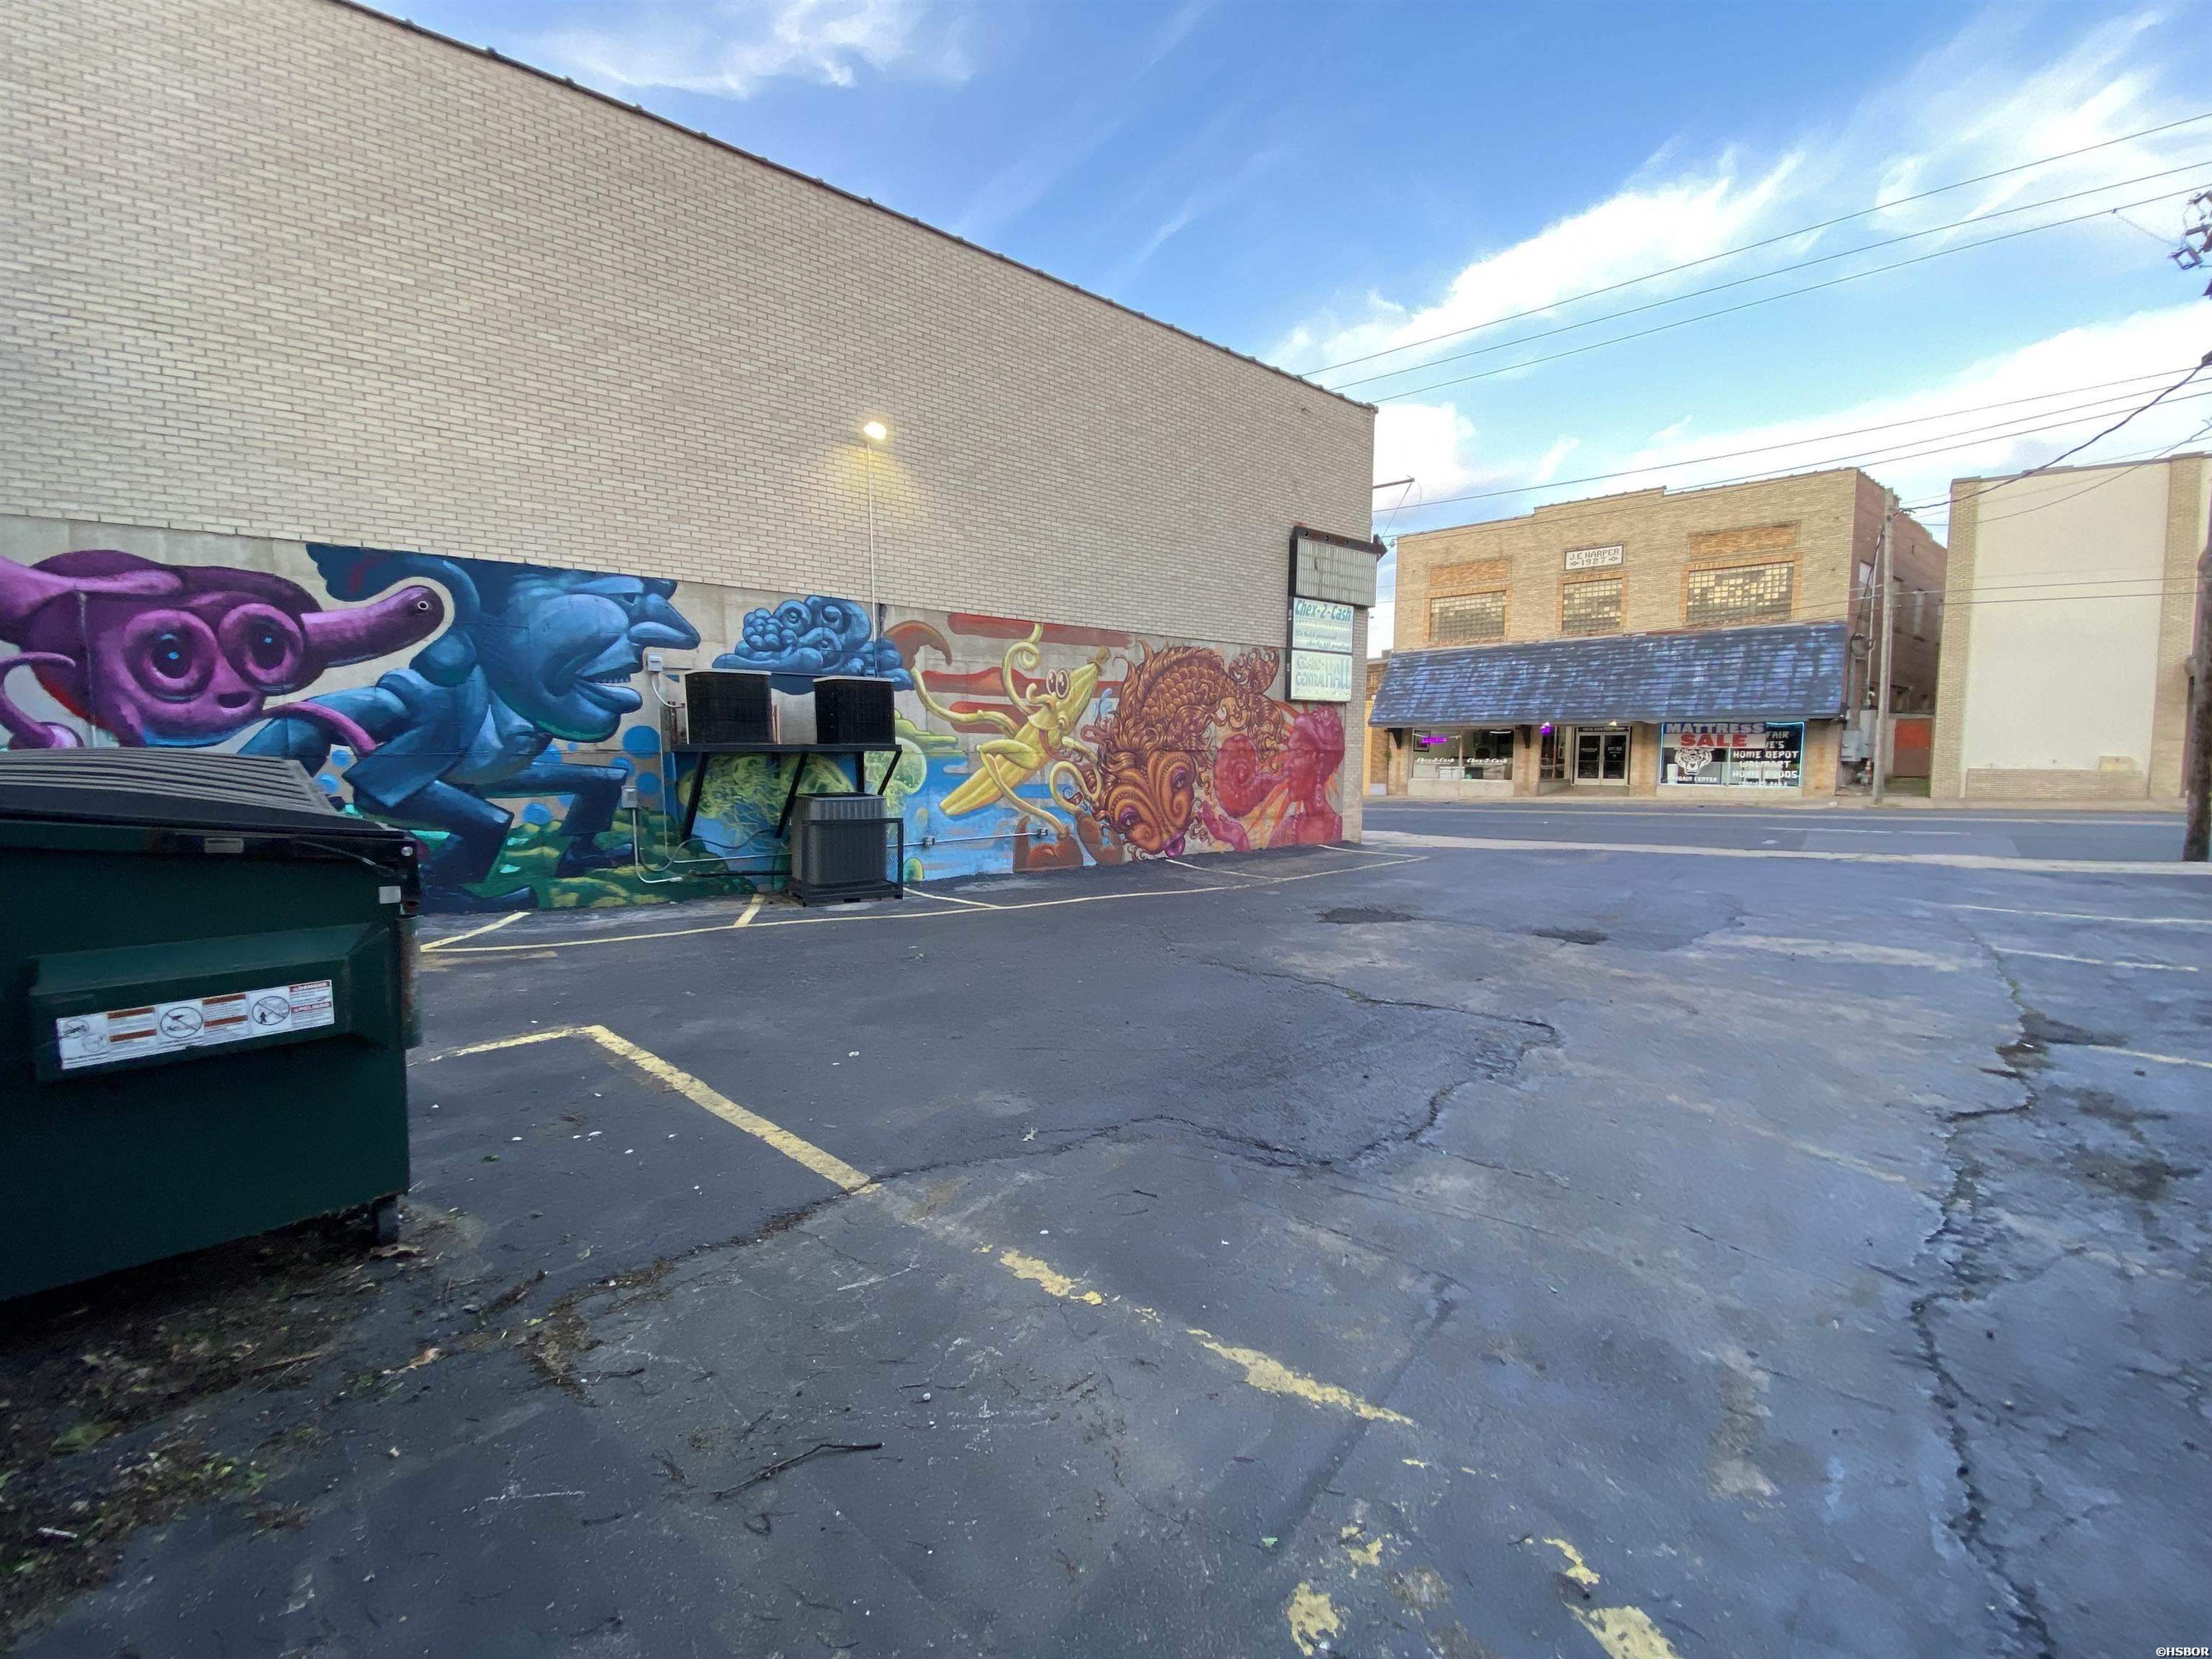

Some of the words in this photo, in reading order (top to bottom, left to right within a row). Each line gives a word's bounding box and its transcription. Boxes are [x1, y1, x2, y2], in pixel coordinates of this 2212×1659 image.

[1585, 548, 1619, 559] HARPER
[1581, 557, 1606, 566] 1927
[1295, 599, 1352, 622] Chex-2-Cash
[1666, 722, 1764, 734] MATTRESS
[1681, 734, 1747, 747] SALE
